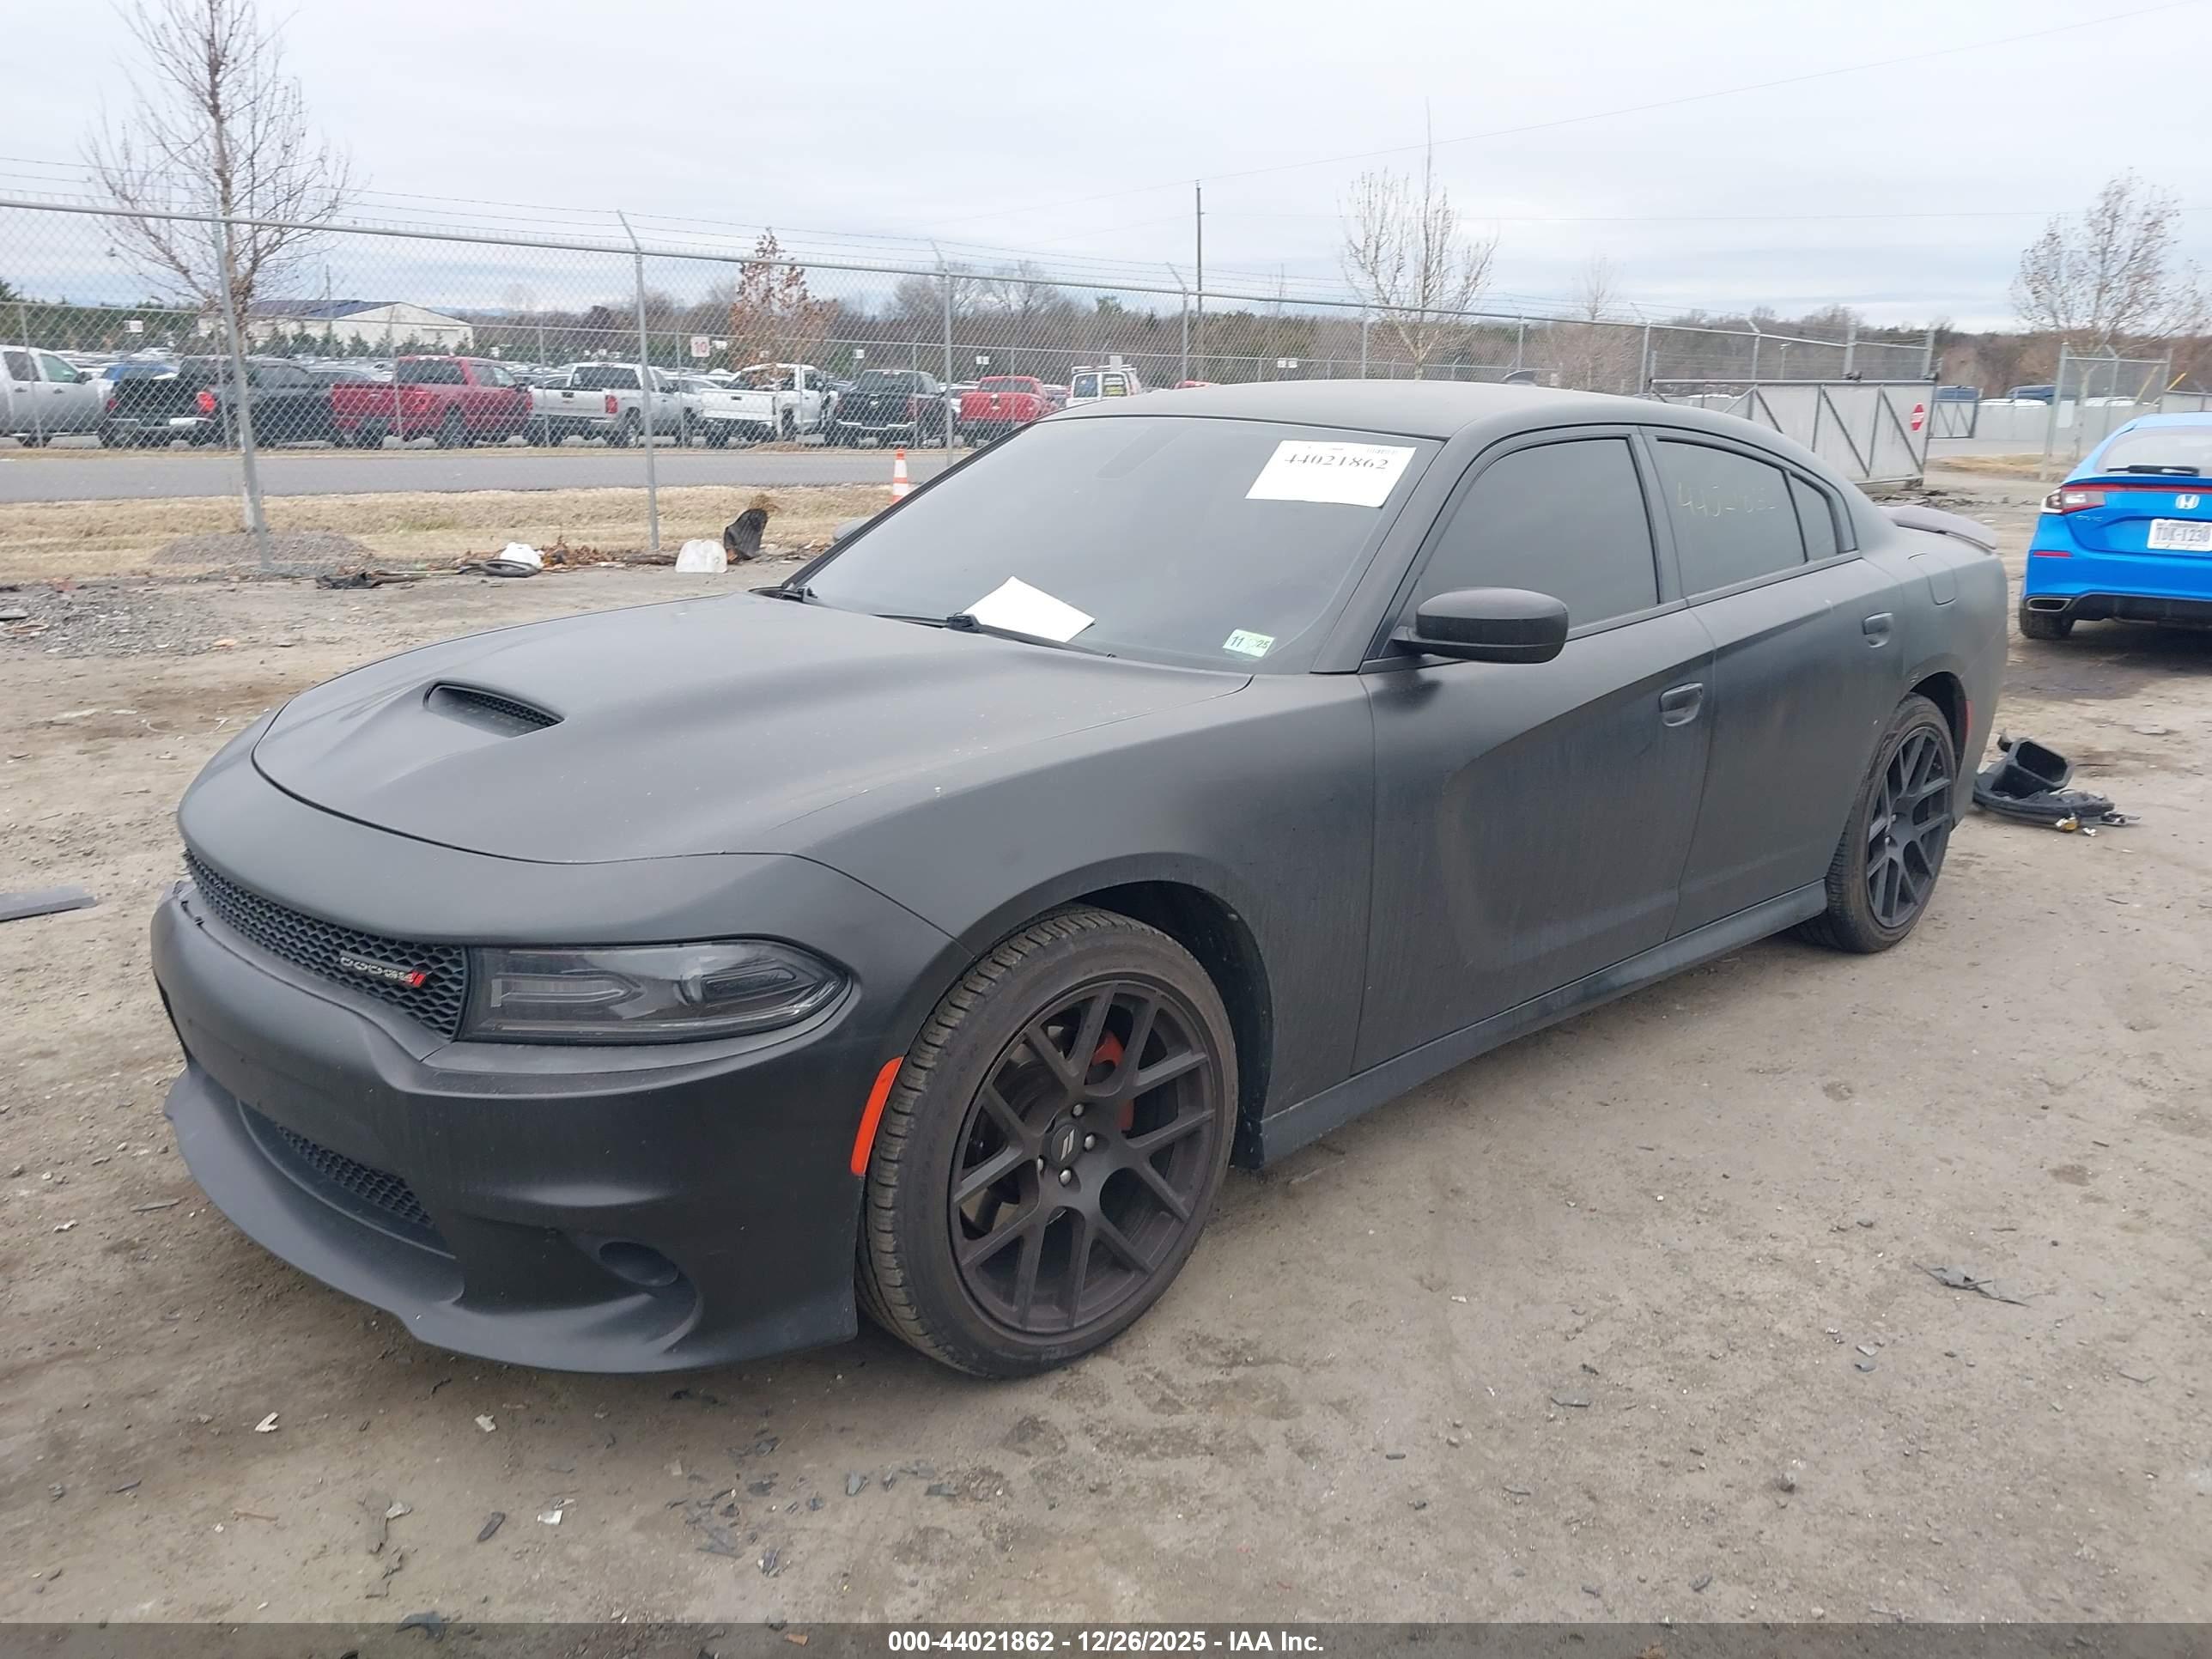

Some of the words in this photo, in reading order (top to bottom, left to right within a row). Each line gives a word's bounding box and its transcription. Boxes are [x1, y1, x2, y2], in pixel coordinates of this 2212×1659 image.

[694, 342, 707, 353] 10
[1285, 453, 1389, 470] 44021862
[1231, 635, 1245, 647] 11
[1256, 639, 1271, 649] 25
[340, 957, 414, 983] DODGE
